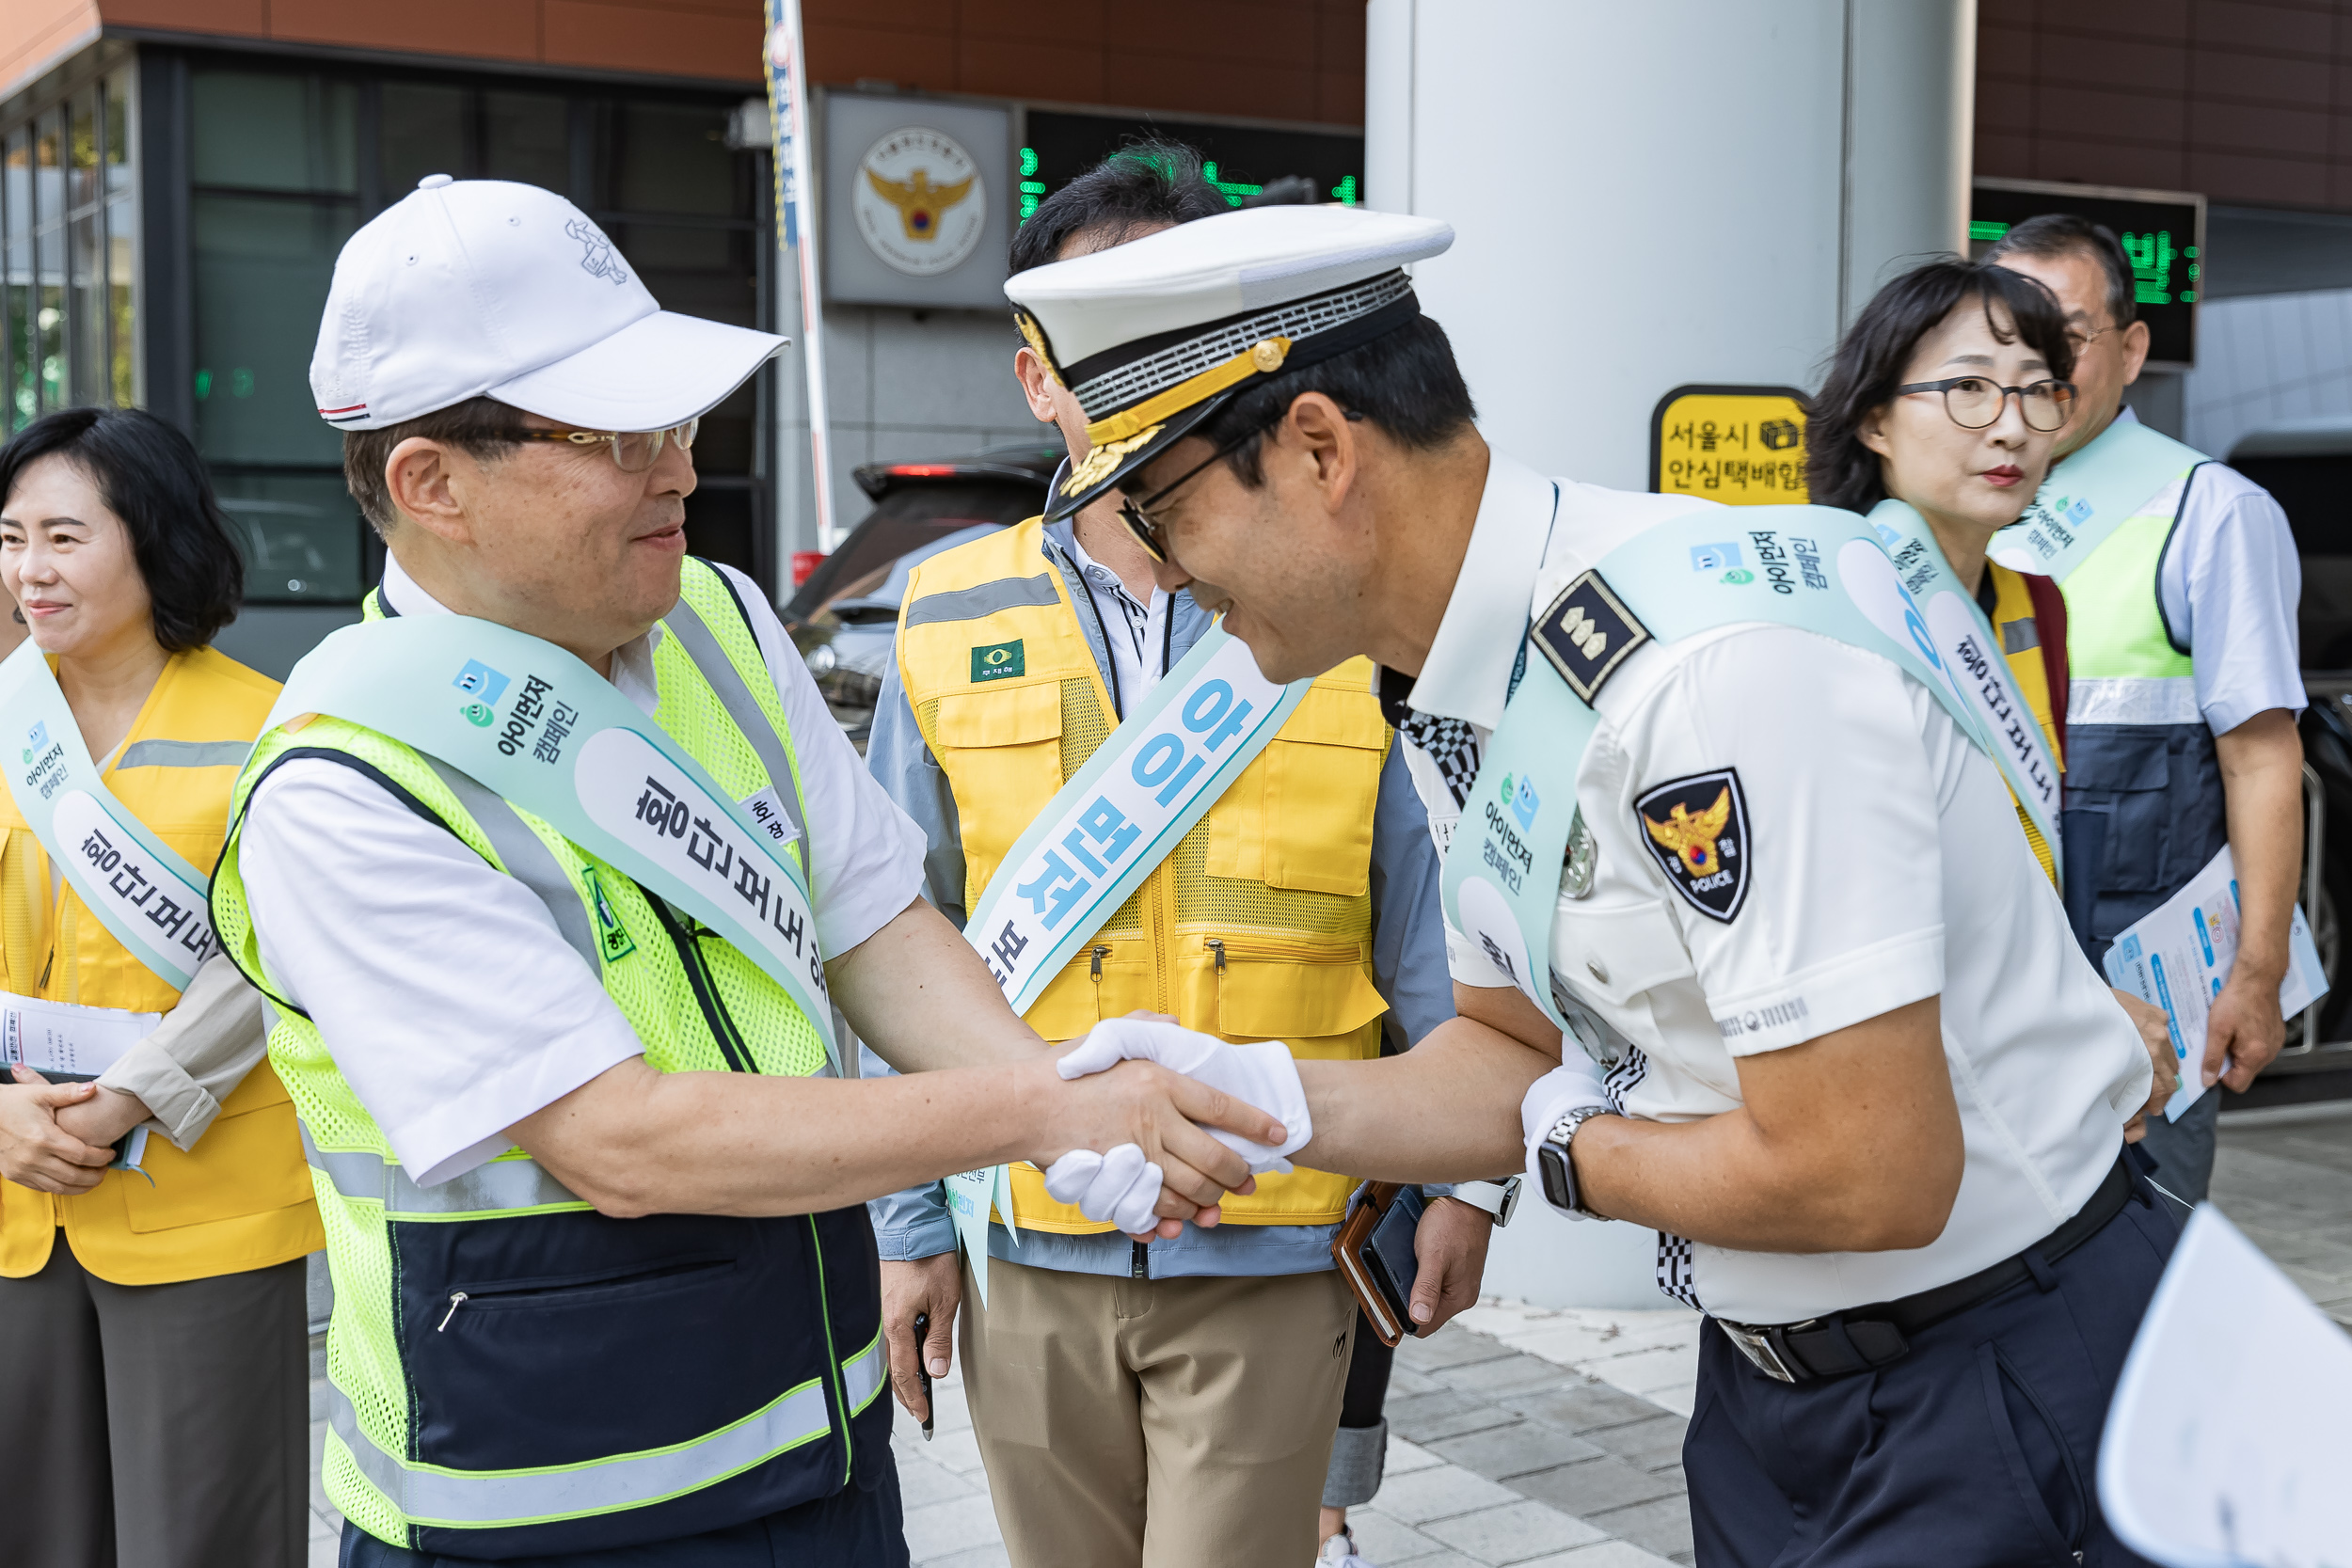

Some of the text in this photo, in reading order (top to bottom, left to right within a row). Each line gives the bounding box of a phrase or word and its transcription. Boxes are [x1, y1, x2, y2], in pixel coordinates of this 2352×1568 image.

[1669, 420, 1748, 451] 서울시
[1669, 458, 1804, 491] 안심택배함
[2038, 509, 2076, 549] 아이먼저
[1748, 531, 1796, 594] 아이먼저
[1788, 537, 1828, 590] 캠페인
[497, 674, 554, 758] 아이먼저
[532, 700, 580, 766] 캠페인
[1957, 634, 2054, 802] 횡단보도
[25, 741, 65, 789] 아이먼저
[39, 763, 69, 800] 캠페인
[635, 775, 804, 960] 횡단보도
[1483, 836, 1522, 896] 캠페인
[1486, 800, 1534, 875] 아이먼저
[81, 829, 219, 964] 횡단보도
[1690, 869, 1735, 894] POLICE
